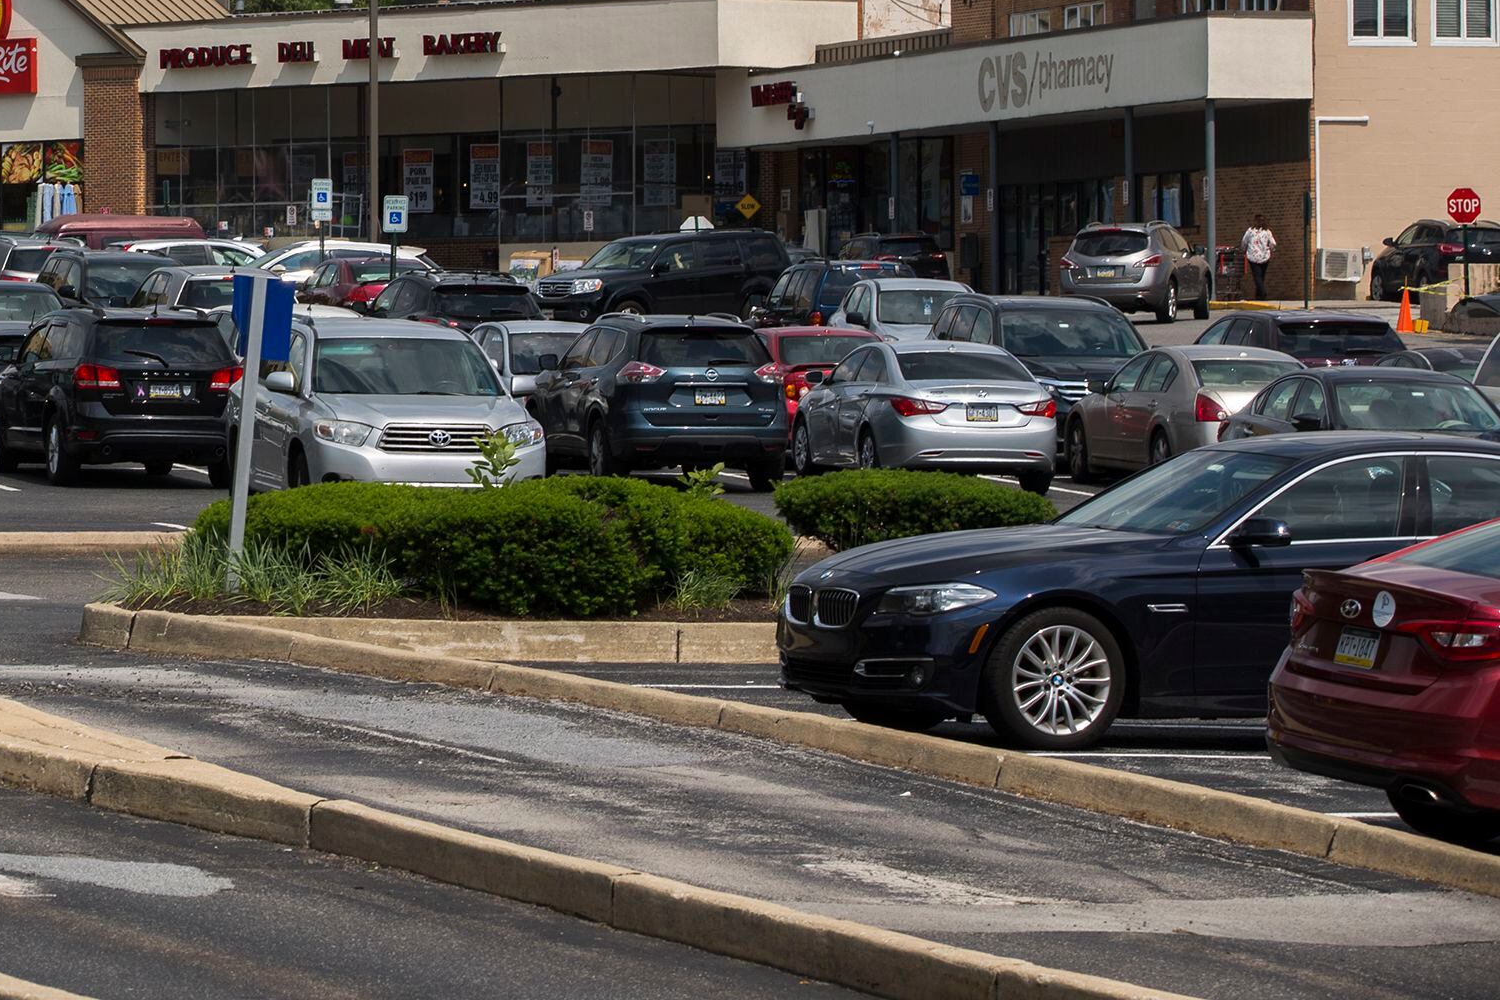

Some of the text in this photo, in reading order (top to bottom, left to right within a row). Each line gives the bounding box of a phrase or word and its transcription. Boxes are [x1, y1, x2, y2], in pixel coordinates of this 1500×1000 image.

[160, 44, 251, 69] PRODUCE
[278, 42, 314, 62] DELI
[423, 32, 502, 55] BAKERY
[1449, 199, 1479, 213] STOP
